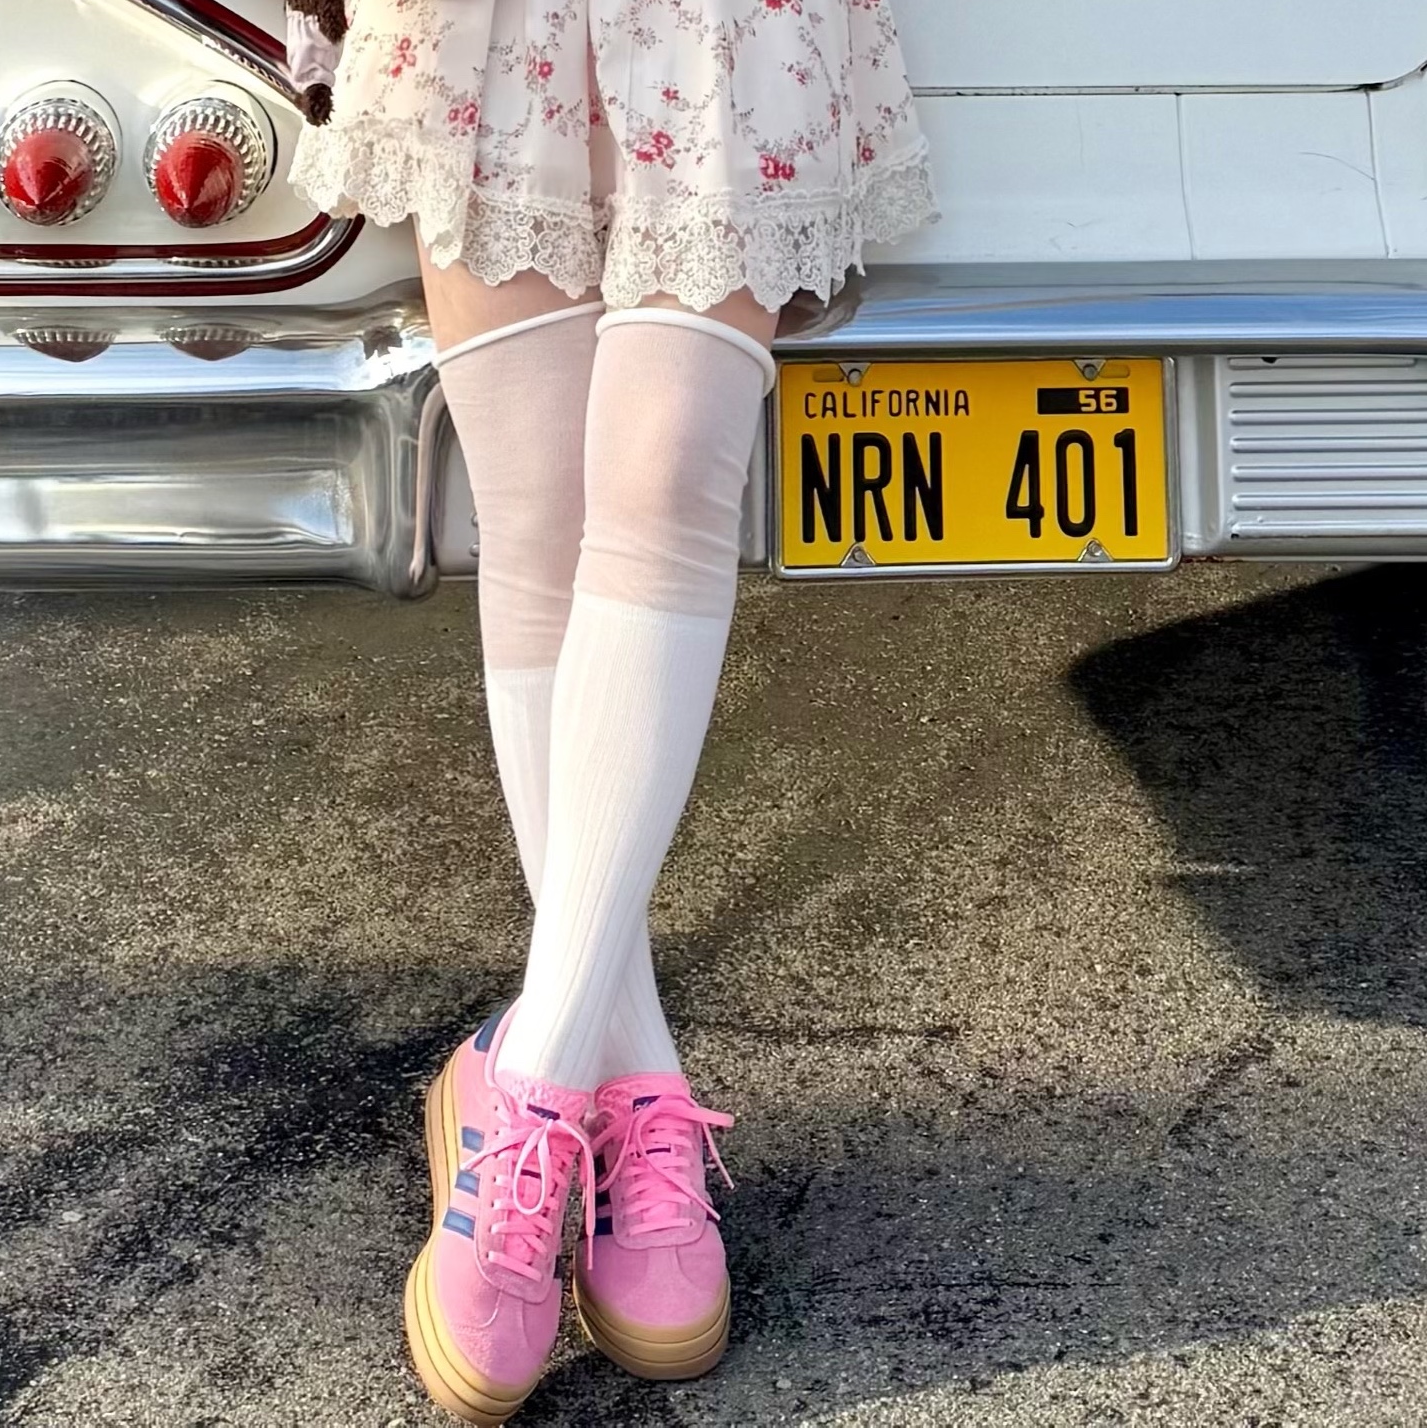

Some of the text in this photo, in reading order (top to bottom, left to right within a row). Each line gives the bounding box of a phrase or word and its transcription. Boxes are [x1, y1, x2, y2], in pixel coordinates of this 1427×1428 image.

[803, 389, 970, 419] CALIFORNIA
[1078, 388, 1118, 412] 56
[801, 428, 1138, 544] NRN 401
